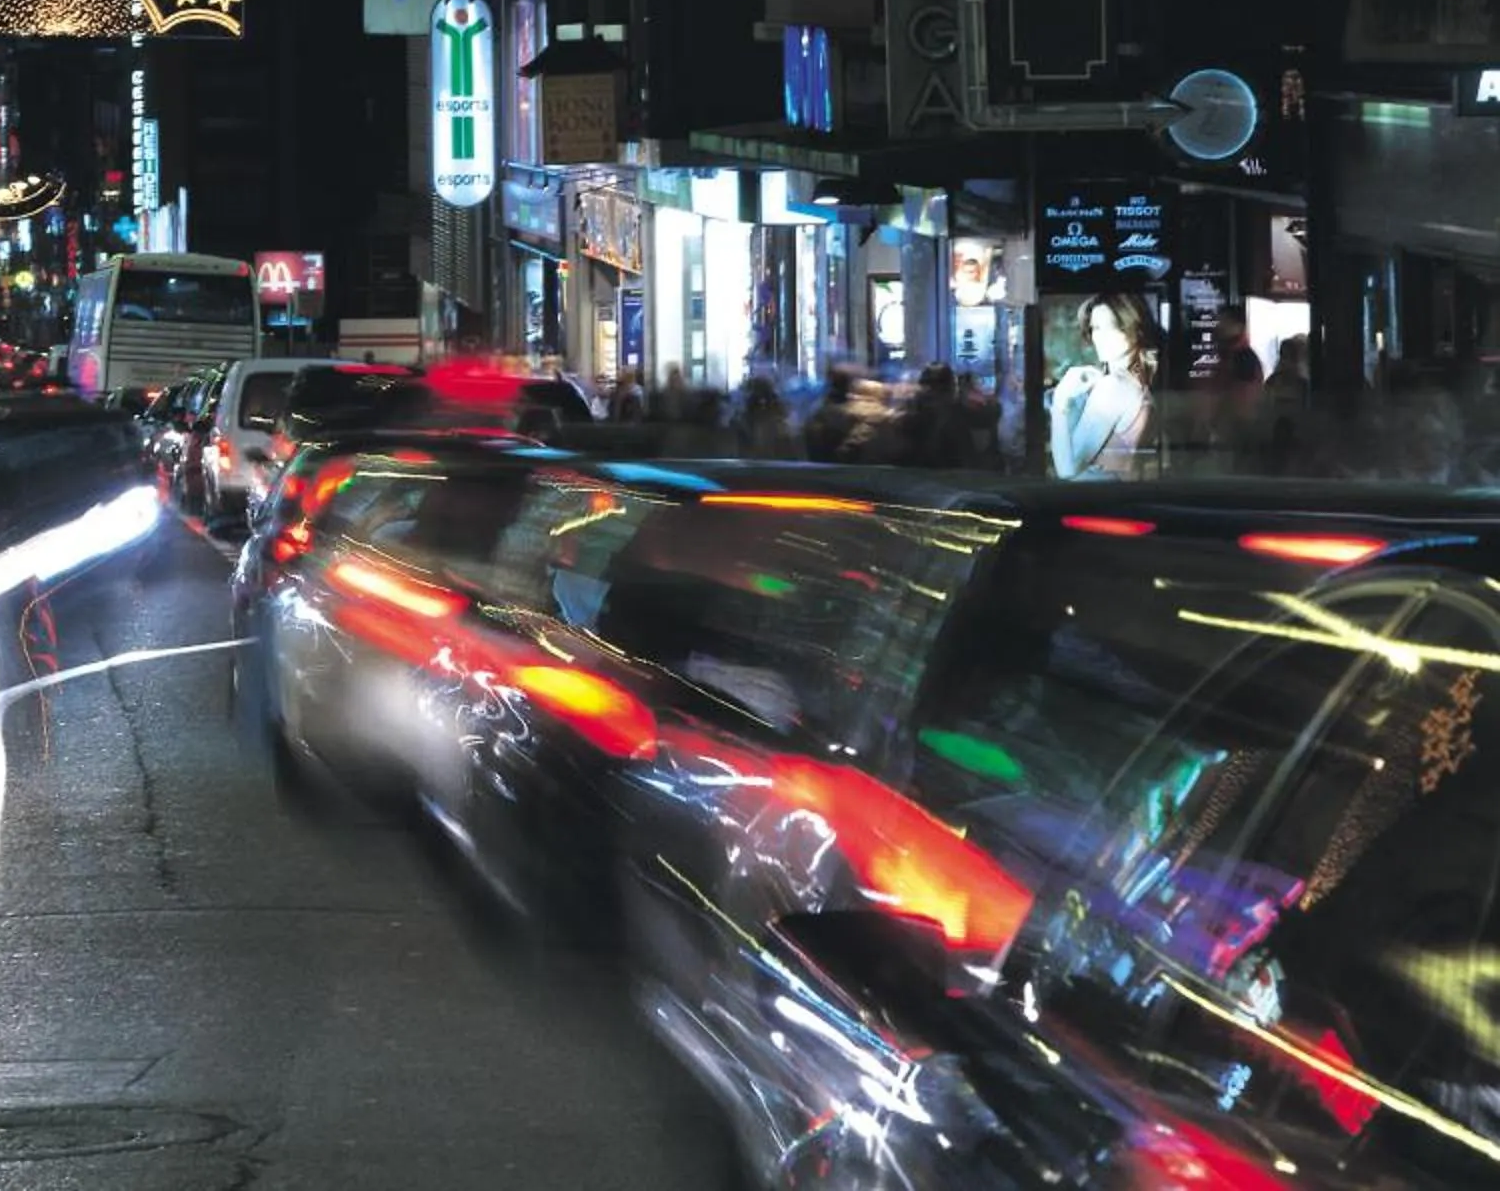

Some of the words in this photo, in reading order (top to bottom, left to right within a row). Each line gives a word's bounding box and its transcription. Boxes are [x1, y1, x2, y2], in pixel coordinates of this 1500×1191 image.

[436, 97, 490, 114] esports
[437, 172, 491, 189] esports
[1115, 206, 1161, 216] TISSOT
[1051, 236, 1099, 248] OMEGA
